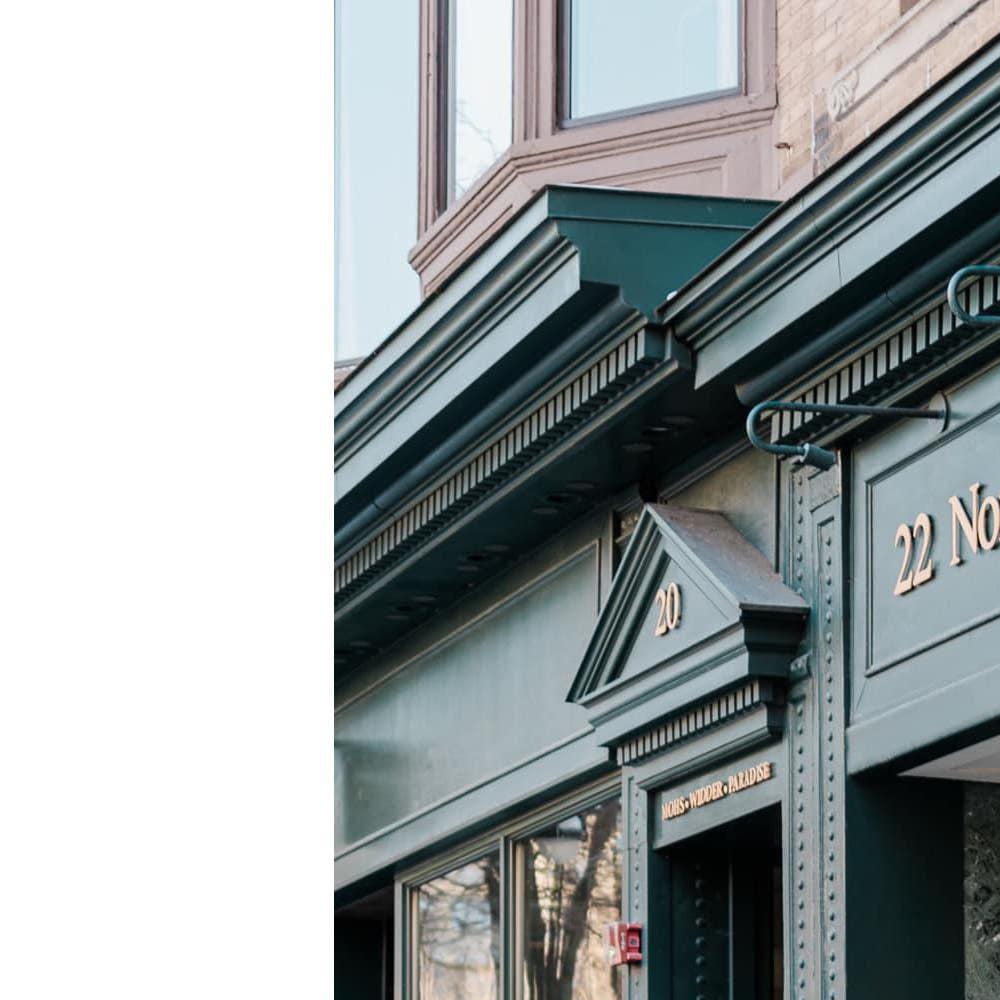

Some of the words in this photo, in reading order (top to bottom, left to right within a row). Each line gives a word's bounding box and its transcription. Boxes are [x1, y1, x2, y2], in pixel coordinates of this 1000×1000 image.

[894, 512, 935, 595] 22
[655, 582, 682, 636] 20
[662, 796, 686, 820] MOHS
[689, 780, 724, 809] WIDDER
[728, 762, 772, 794] PARADISE
